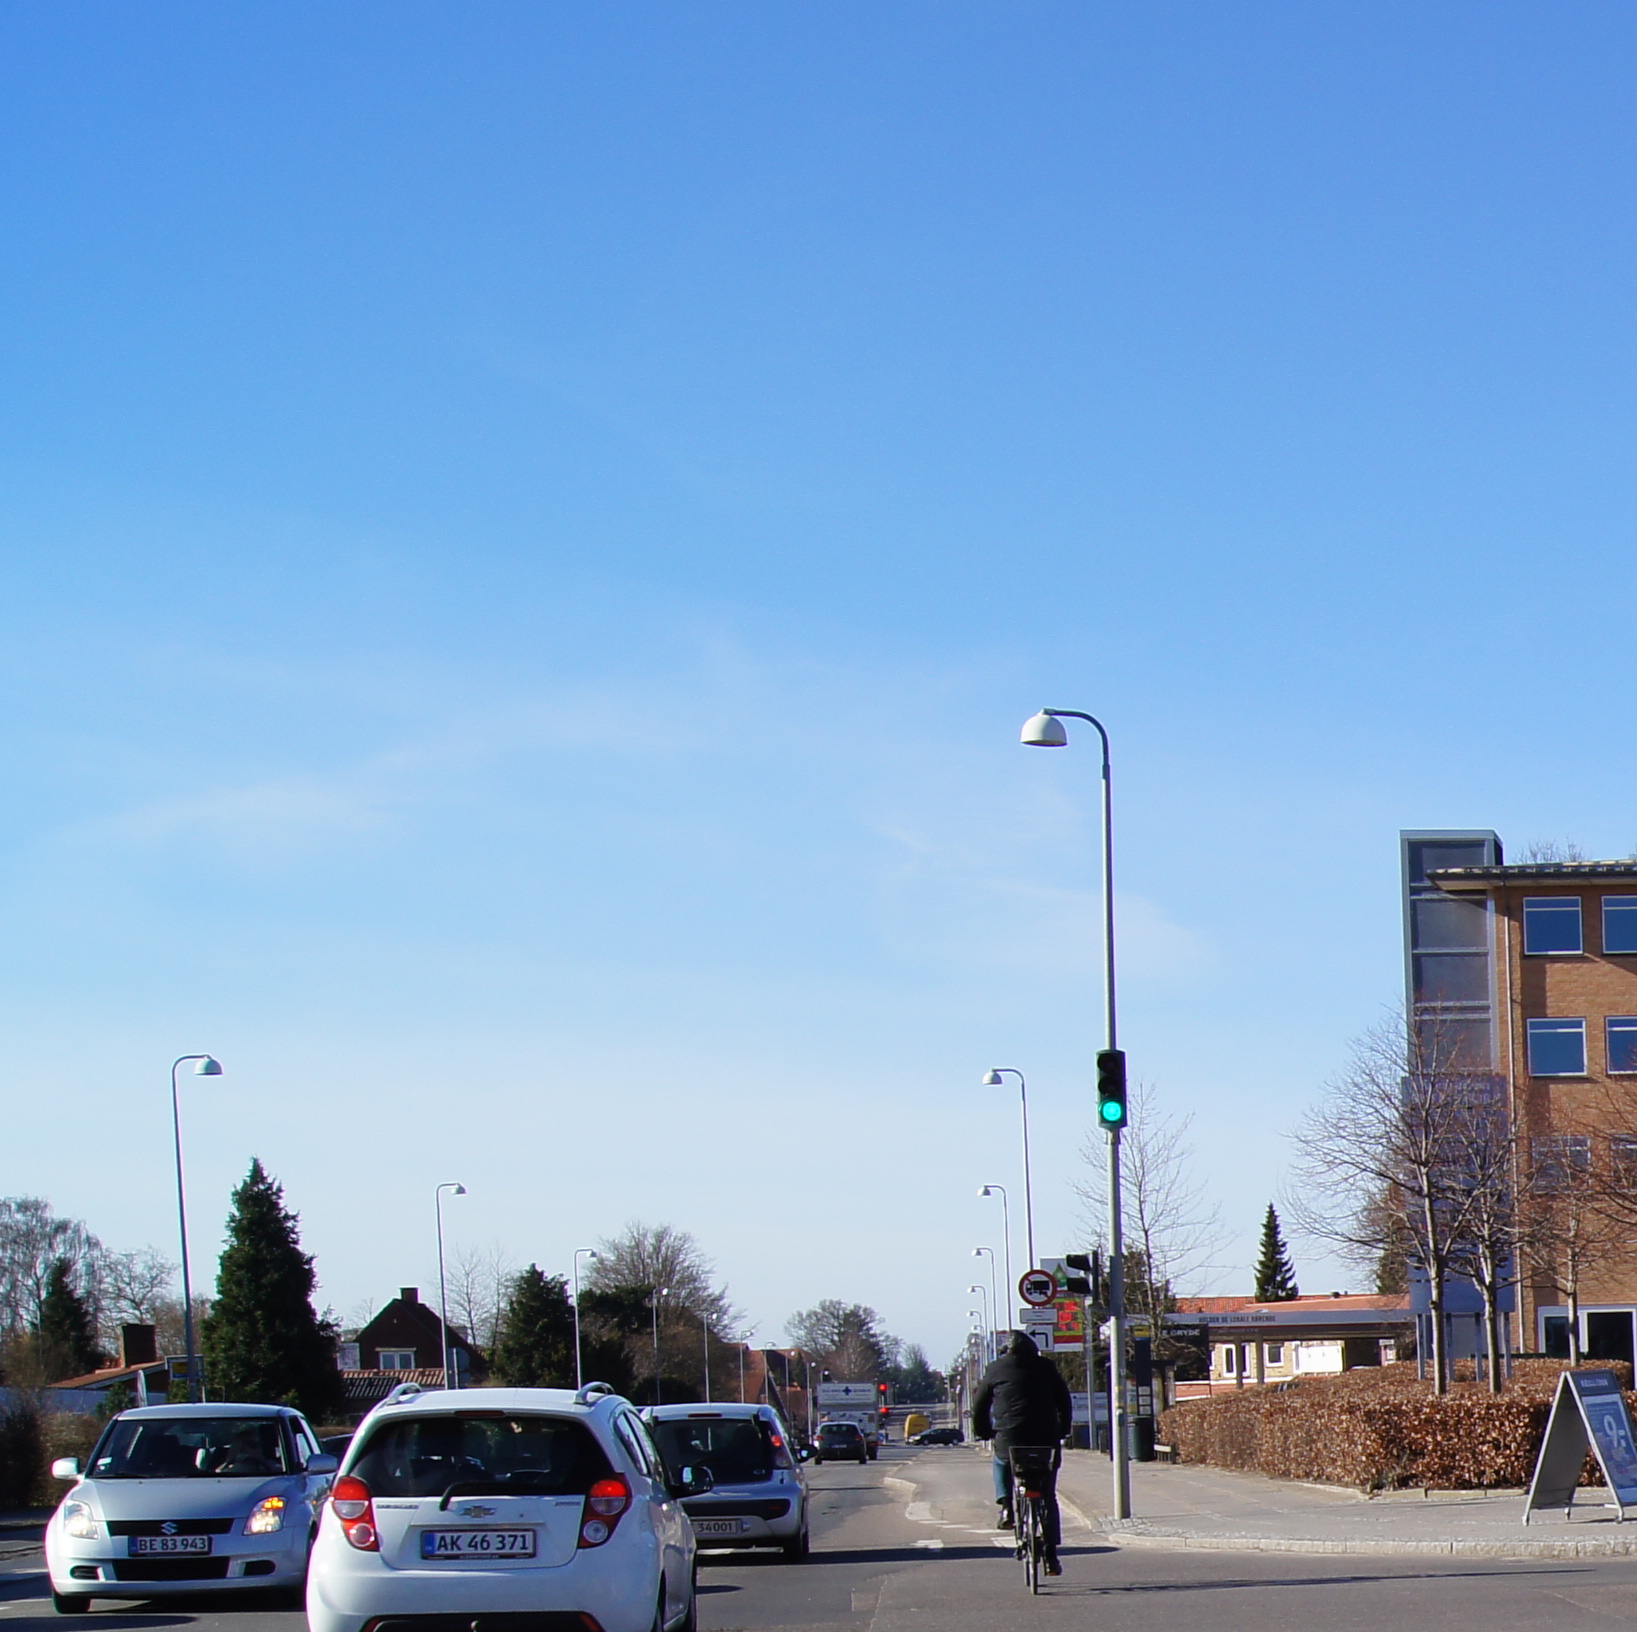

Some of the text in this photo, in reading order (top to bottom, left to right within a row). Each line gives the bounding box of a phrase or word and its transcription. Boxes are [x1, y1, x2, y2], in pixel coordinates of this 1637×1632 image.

[139, 1536, 207, 1551] BE 83 943
[437, 1533, 528, 1551] AK 46 371
